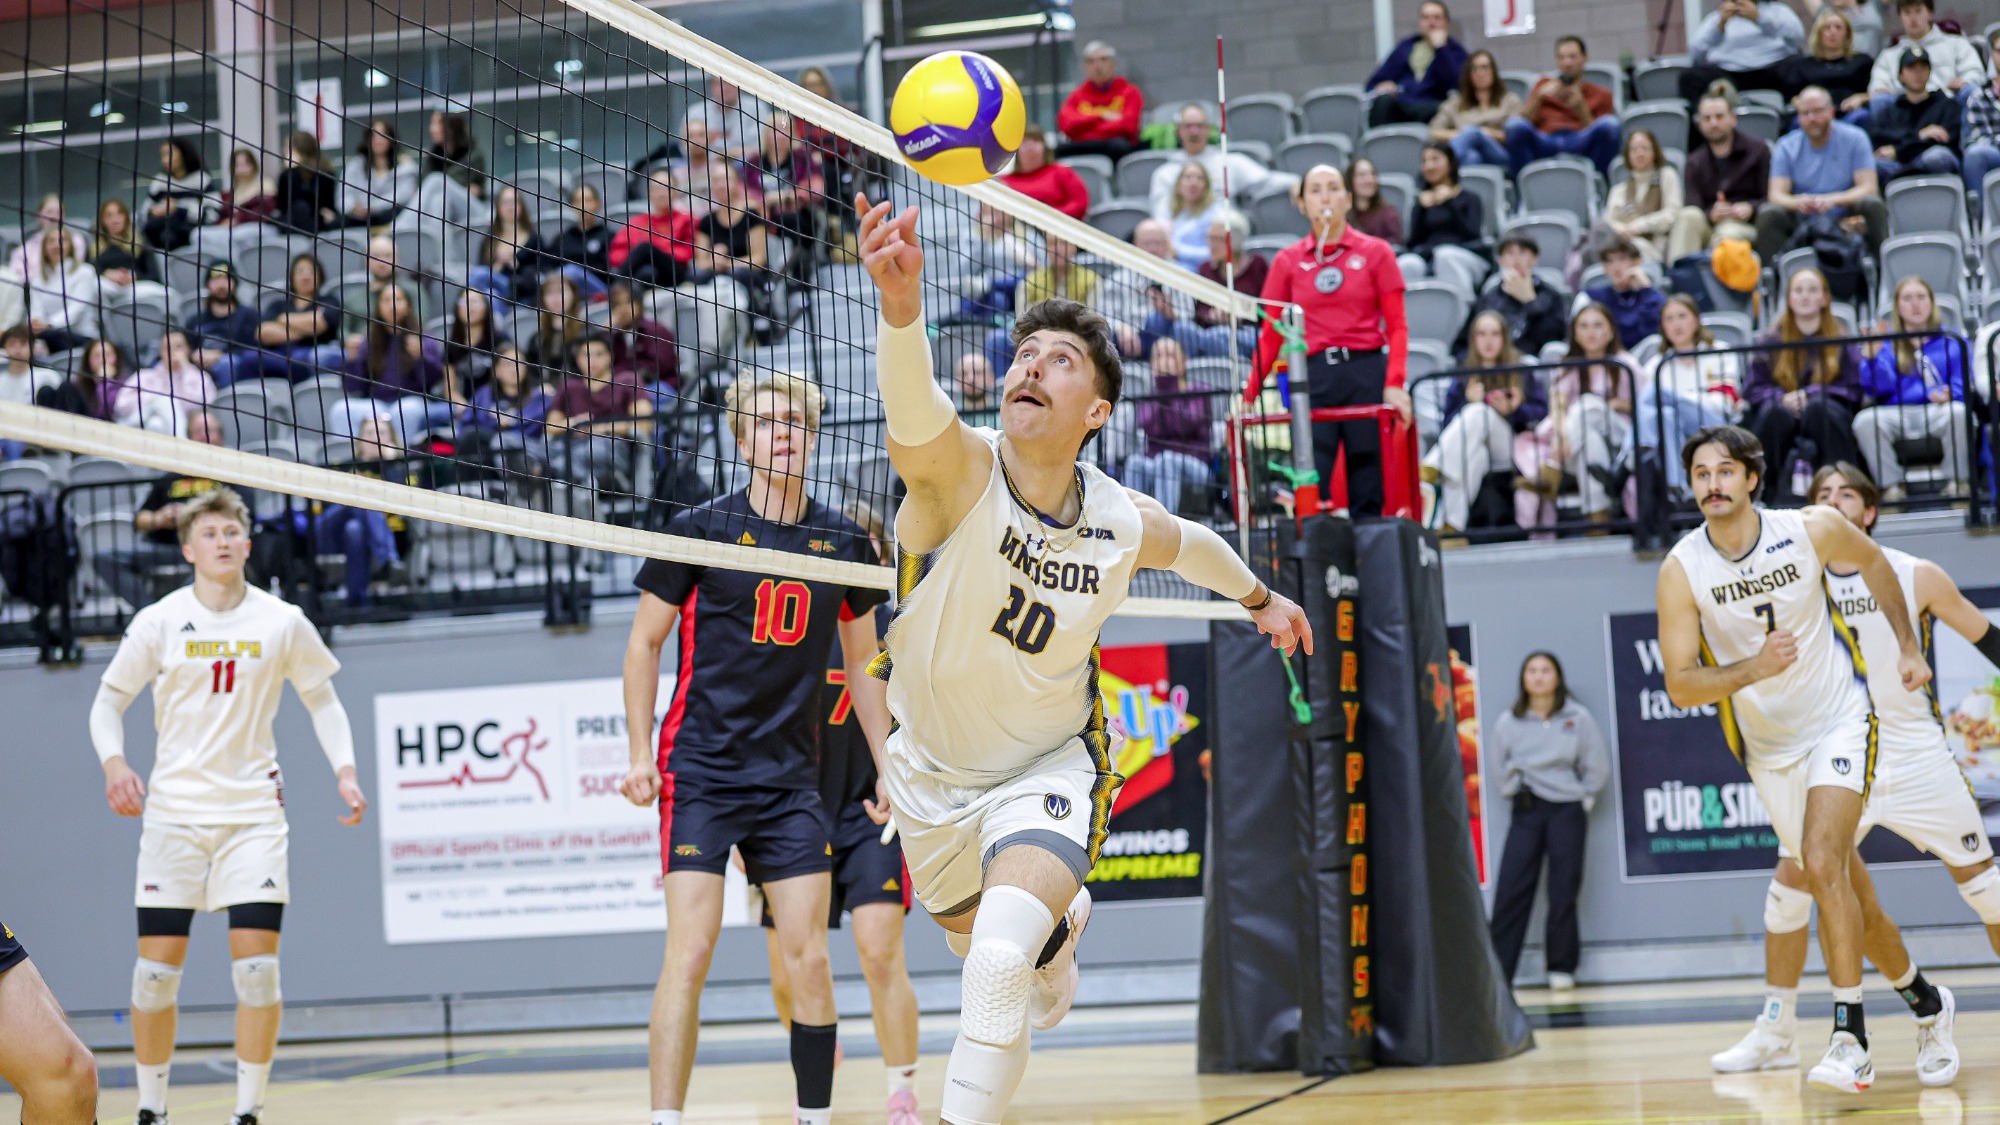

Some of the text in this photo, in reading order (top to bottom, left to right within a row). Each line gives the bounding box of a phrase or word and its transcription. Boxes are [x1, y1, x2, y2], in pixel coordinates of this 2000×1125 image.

[1766, 538, 1794, 554] OUA
[1711, 563, 1801, 605] WINDSOR
[752, 578, 811, 646] 10
[989, 584, 1057, 655] 20
[1753, 602, 1777, 635] 7
[185, 641, 262, 659] GUELPH
[211, 659, 236, 694] 11
[826, 669, 852, 725] 7
[396, 720, 501, 766] HPC
[1336, 600, 1370, 999] GRYPHONS
[1643, 780, 1771, 833] PÜR&SIM
[1102, 829, 1189, 856] WINGS
